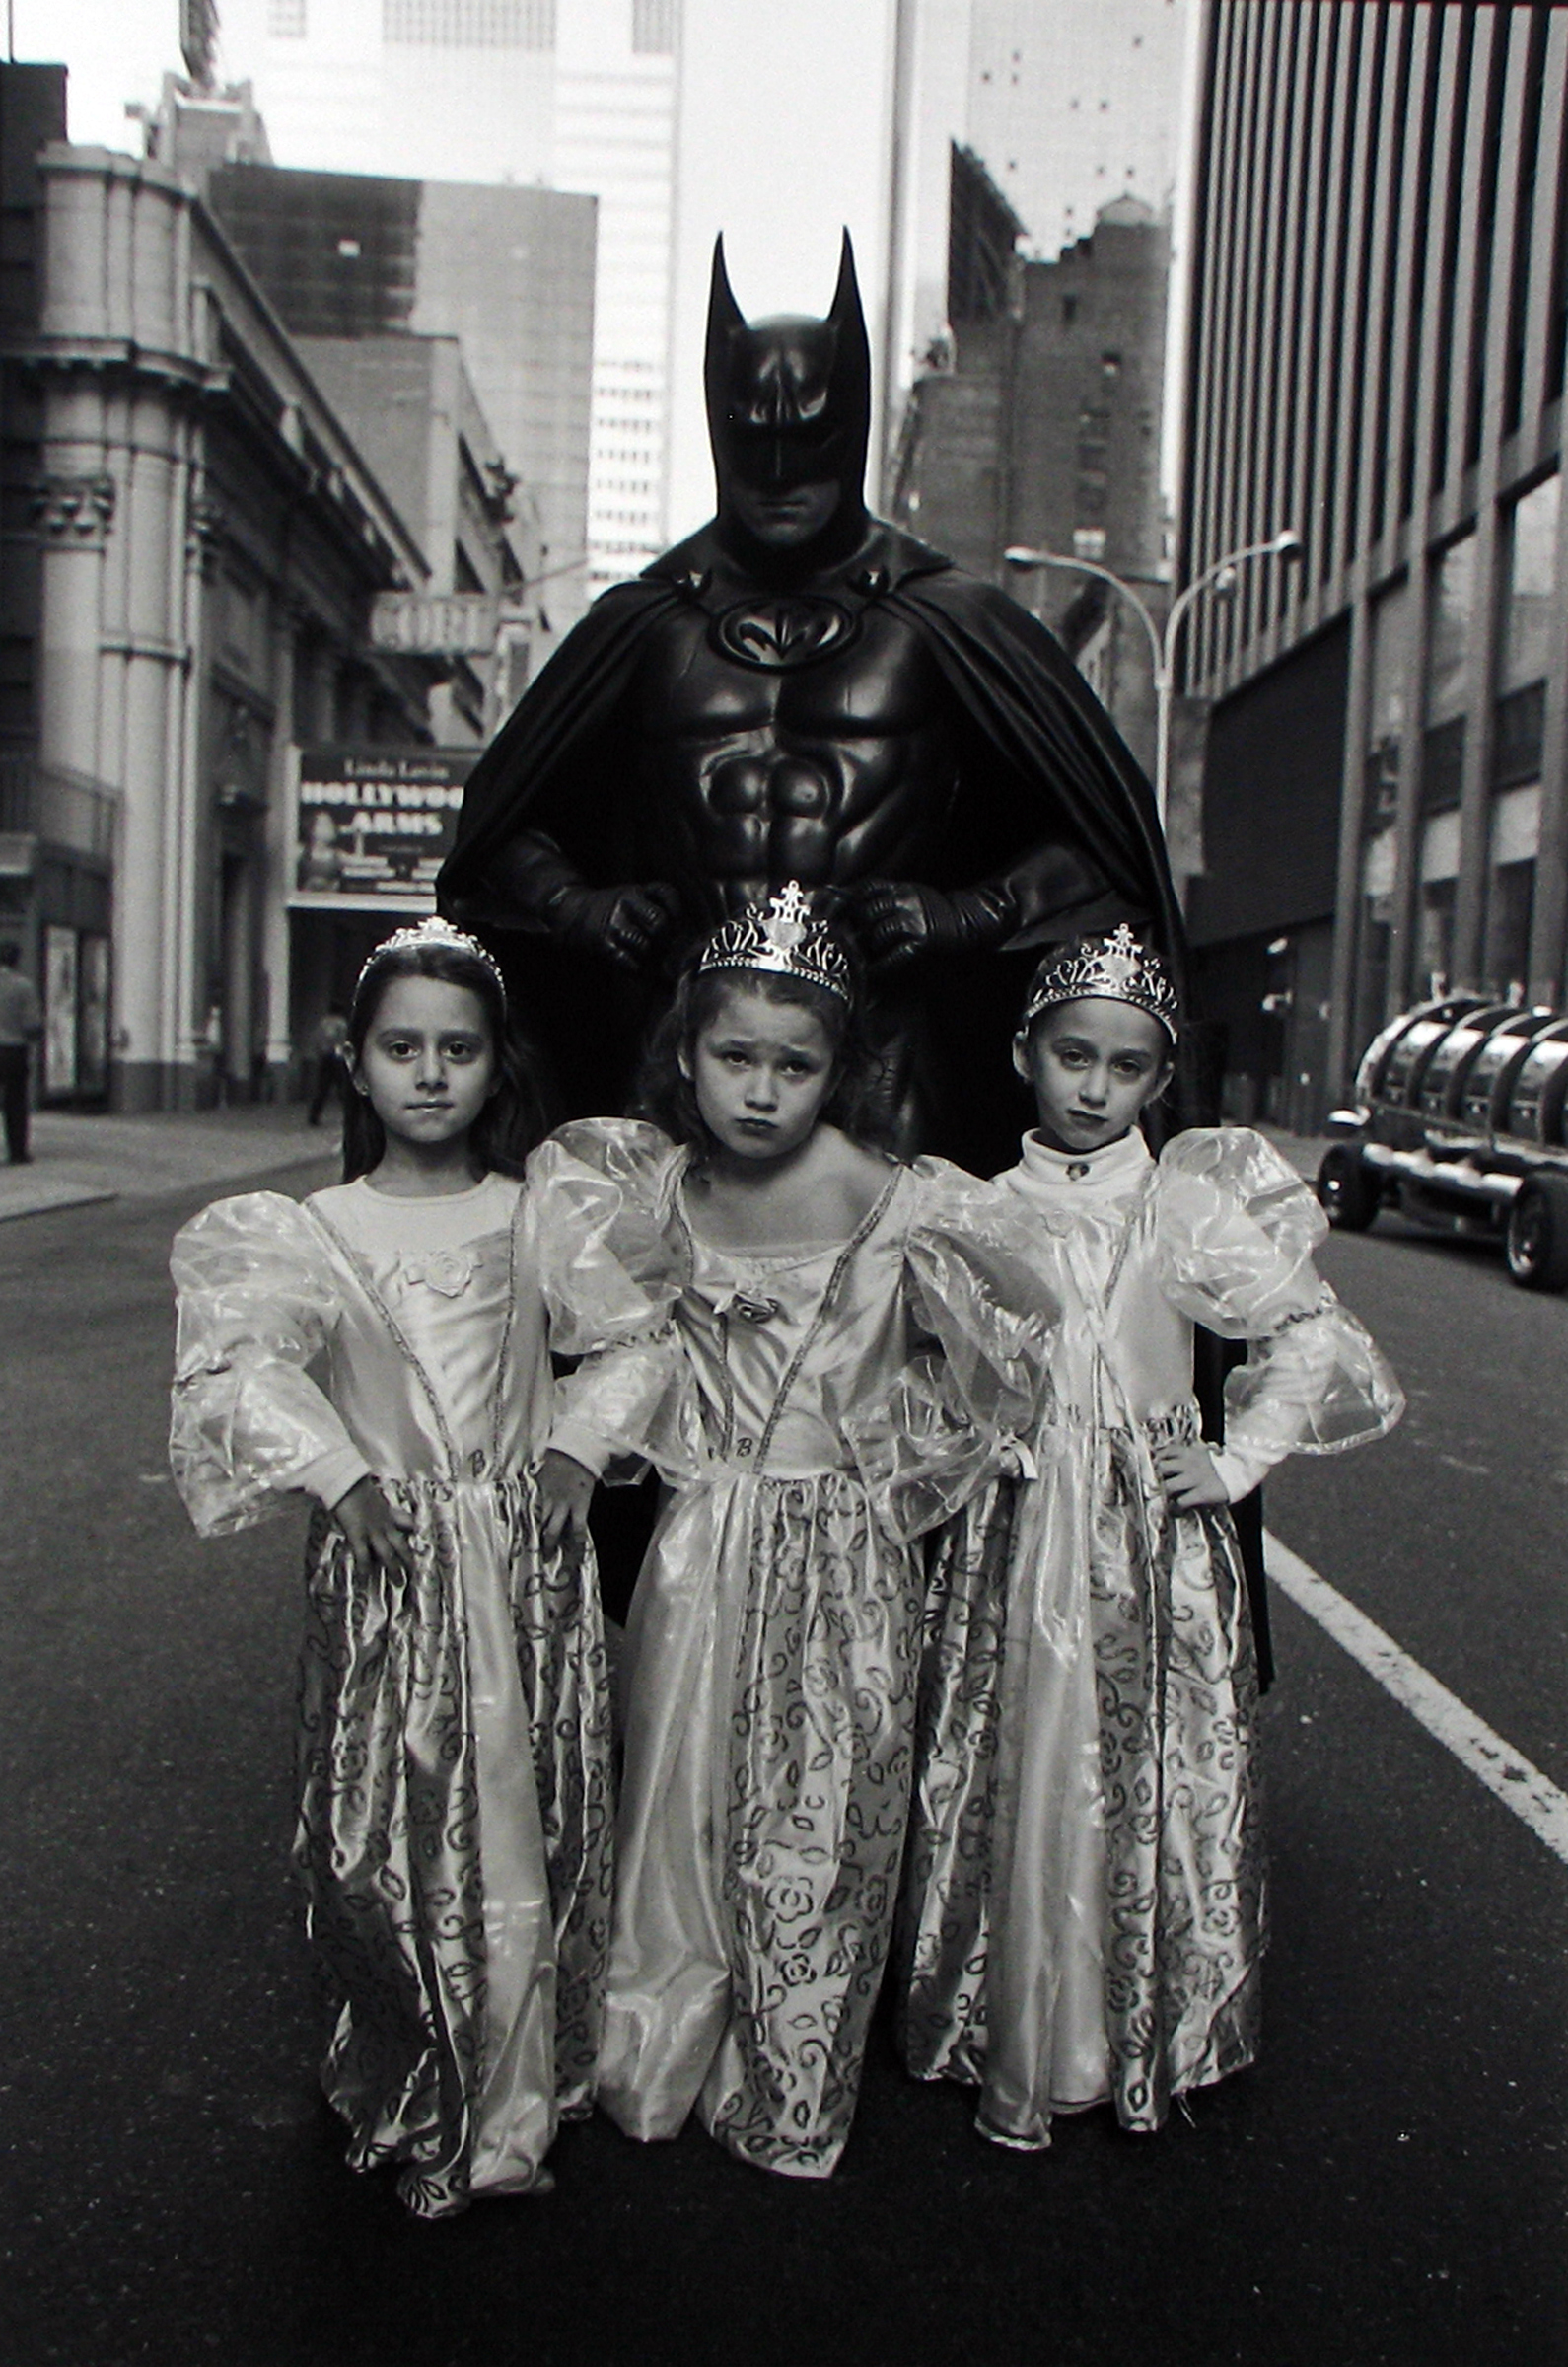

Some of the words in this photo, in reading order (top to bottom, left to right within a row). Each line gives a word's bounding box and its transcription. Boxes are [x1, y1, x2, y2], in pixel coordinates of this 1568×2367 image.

[301, 782, 464, 810] HOLLYWOO
[352, 811, 444, 834] ARMS
[736, 1436, 753, 1458] B
